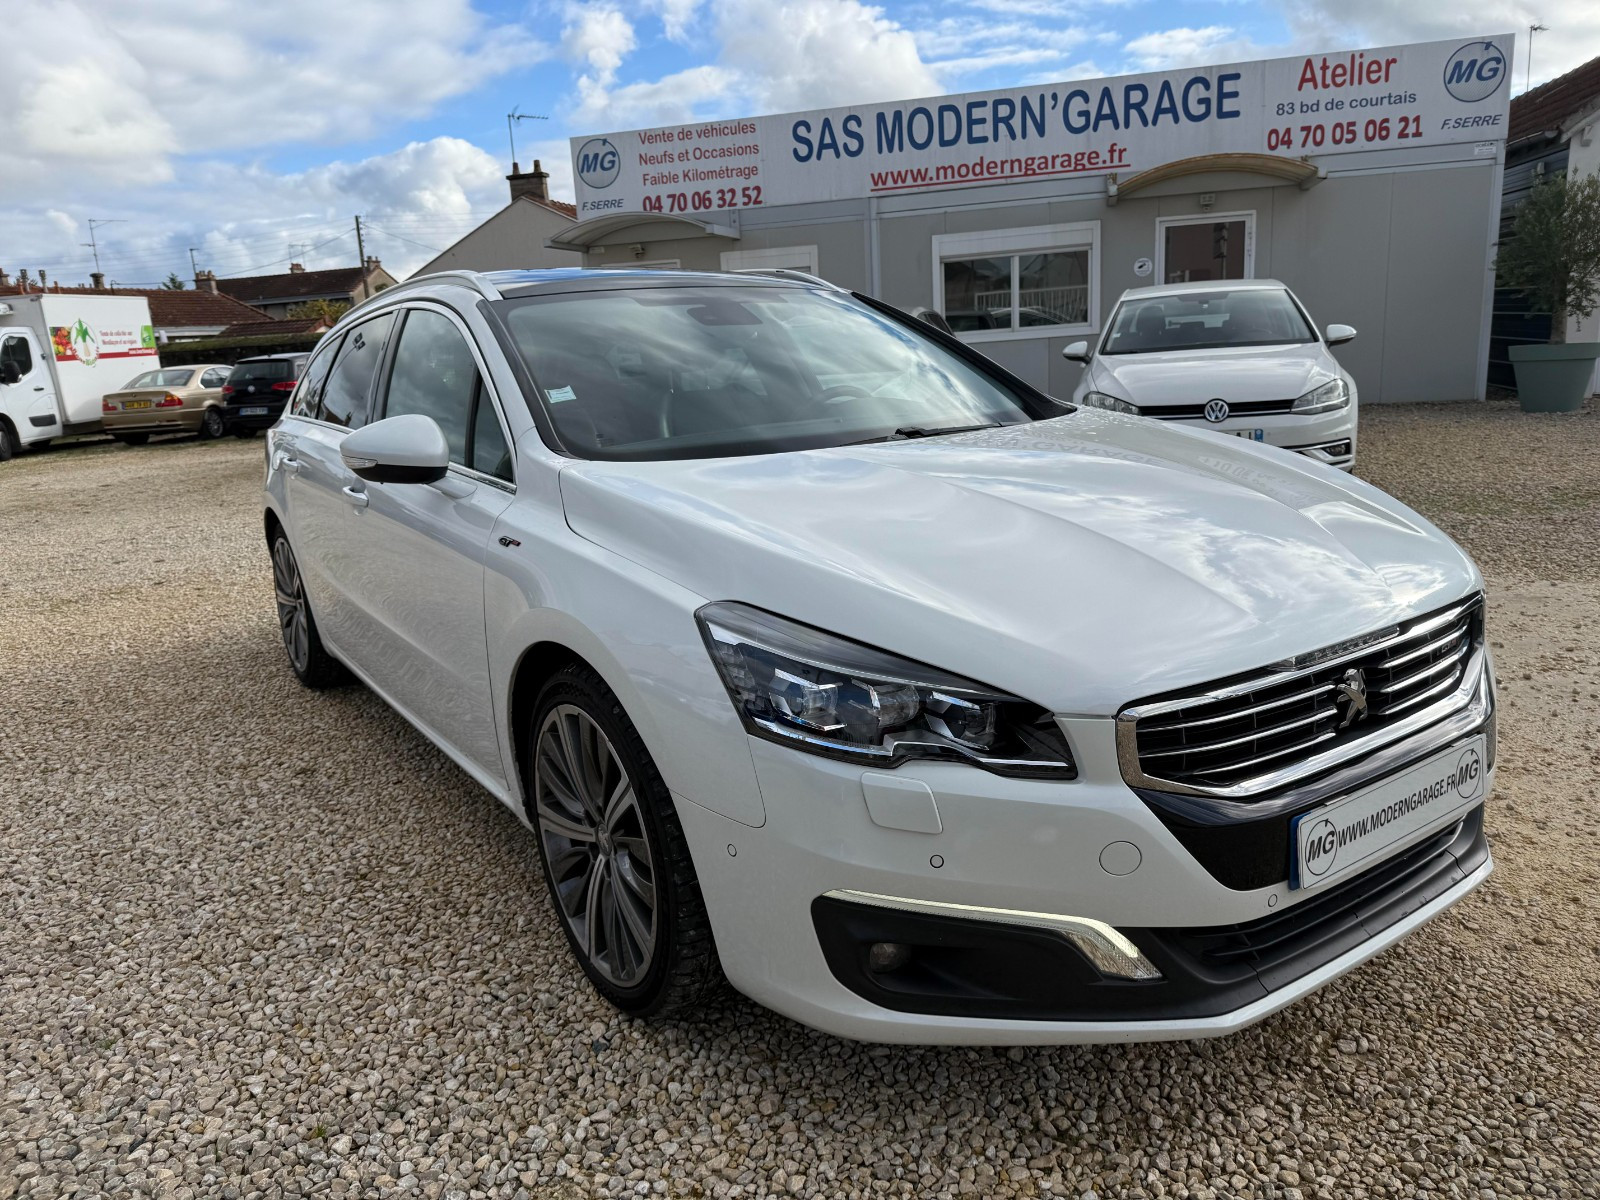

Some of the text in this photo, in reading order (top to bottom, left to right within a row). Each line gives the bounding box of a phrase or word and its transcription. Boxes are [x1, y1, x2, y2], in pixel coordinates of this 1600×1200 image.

[1297, 53, 1398, 91] Atelier
[1446, 57, 1502, 85] MG
[1276, 91, 1417, 116] 83 bd de courtais
[638, 121, 756, 145] Vente de véhicules
[792, 114, 865, 163] SAS
[1267, 114, 1423, 151] 04 70 05 06 21
[580, 151, 617, 174] MG
[639, 143, 759, 166] Neufs et Occasions
[871, 143, 1129, 190] www.moderngarage.fr
[642, 164, 759, 187] Faible Kilométrage
[642, 185, 763, 213] 04 70 06 32 52
[1307, 759, 1479, 863] MG WWW.MODERNGARAGE.FR MG
